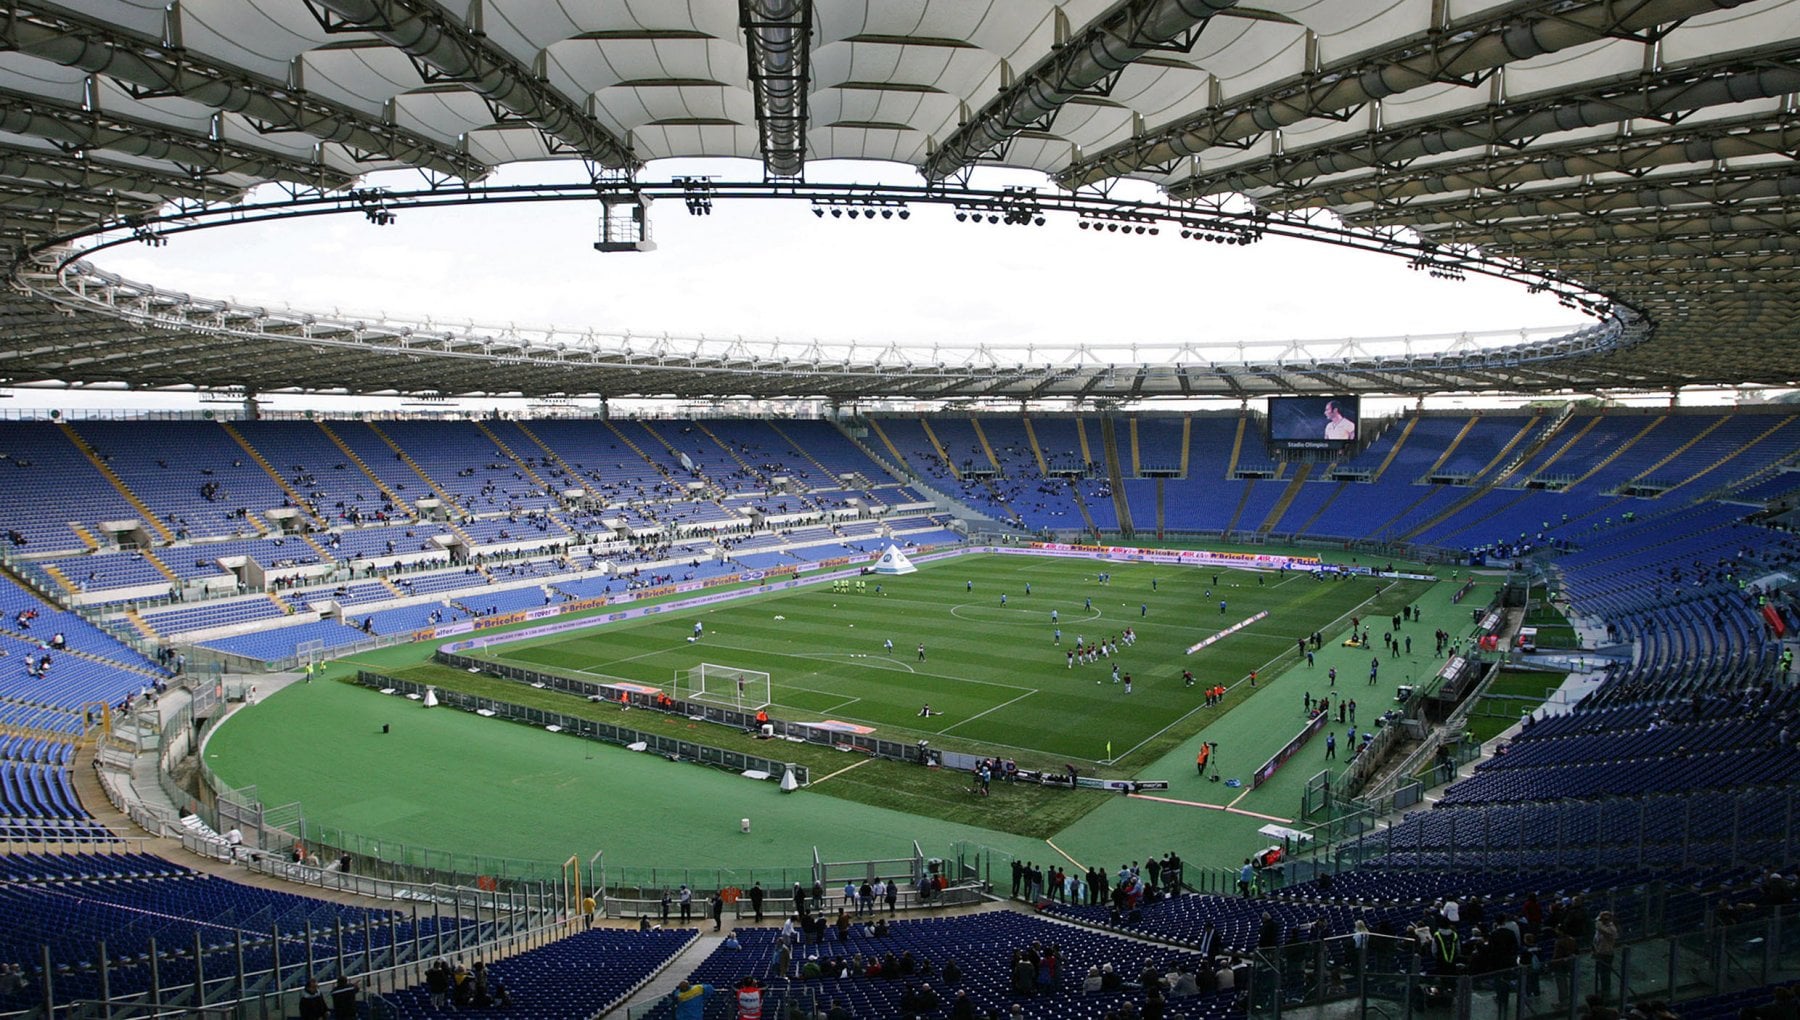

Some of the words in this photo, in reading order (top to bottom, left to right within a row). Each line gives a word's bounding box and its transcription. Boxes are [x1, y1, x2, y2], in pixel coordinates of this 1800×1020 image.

[1146, 549, 1179, 557] Bricofer
[1219, 553, 1254, 561] Bricofer
[569, 600, 605, 611] Bricofer
[484, 615, 525, 627] Bricofer
